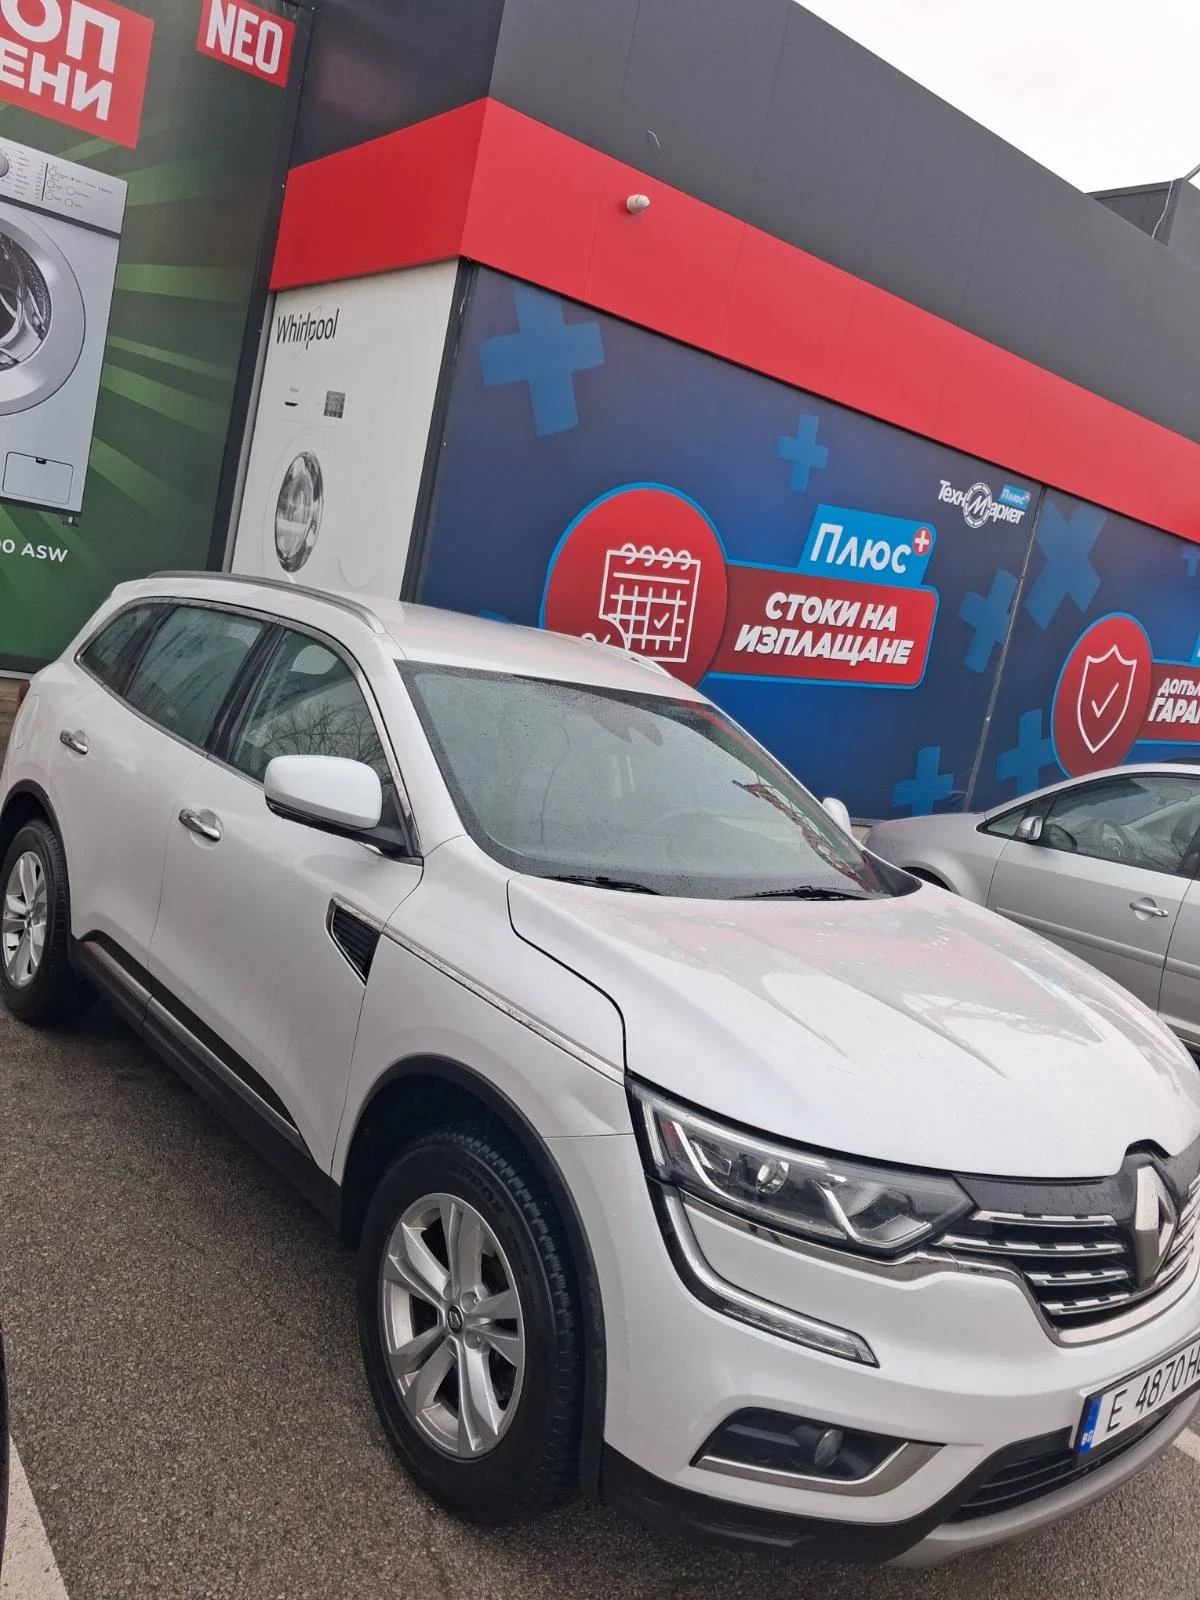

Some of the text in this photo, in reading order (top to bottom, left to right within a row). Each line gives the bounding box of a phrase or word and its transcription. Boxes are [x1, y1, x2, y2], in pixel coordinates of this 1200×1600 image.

[206, 0, 283, 75] NEO
[0, 36, 112, 121] ЕНИ
[276, 309, 339, 350] Whirlpool
[21, 542, 68, 562] ASW
[765, 591, 898, 632] СТОКИ НА
[734, 624, 915, 667] ИЗПЛАЩАНЕ
[1147, 696, 1200, 724] ГАРА
[1106, 1388, 1128, 1434] E
[1081, 1430, 1094, 1446] BG
